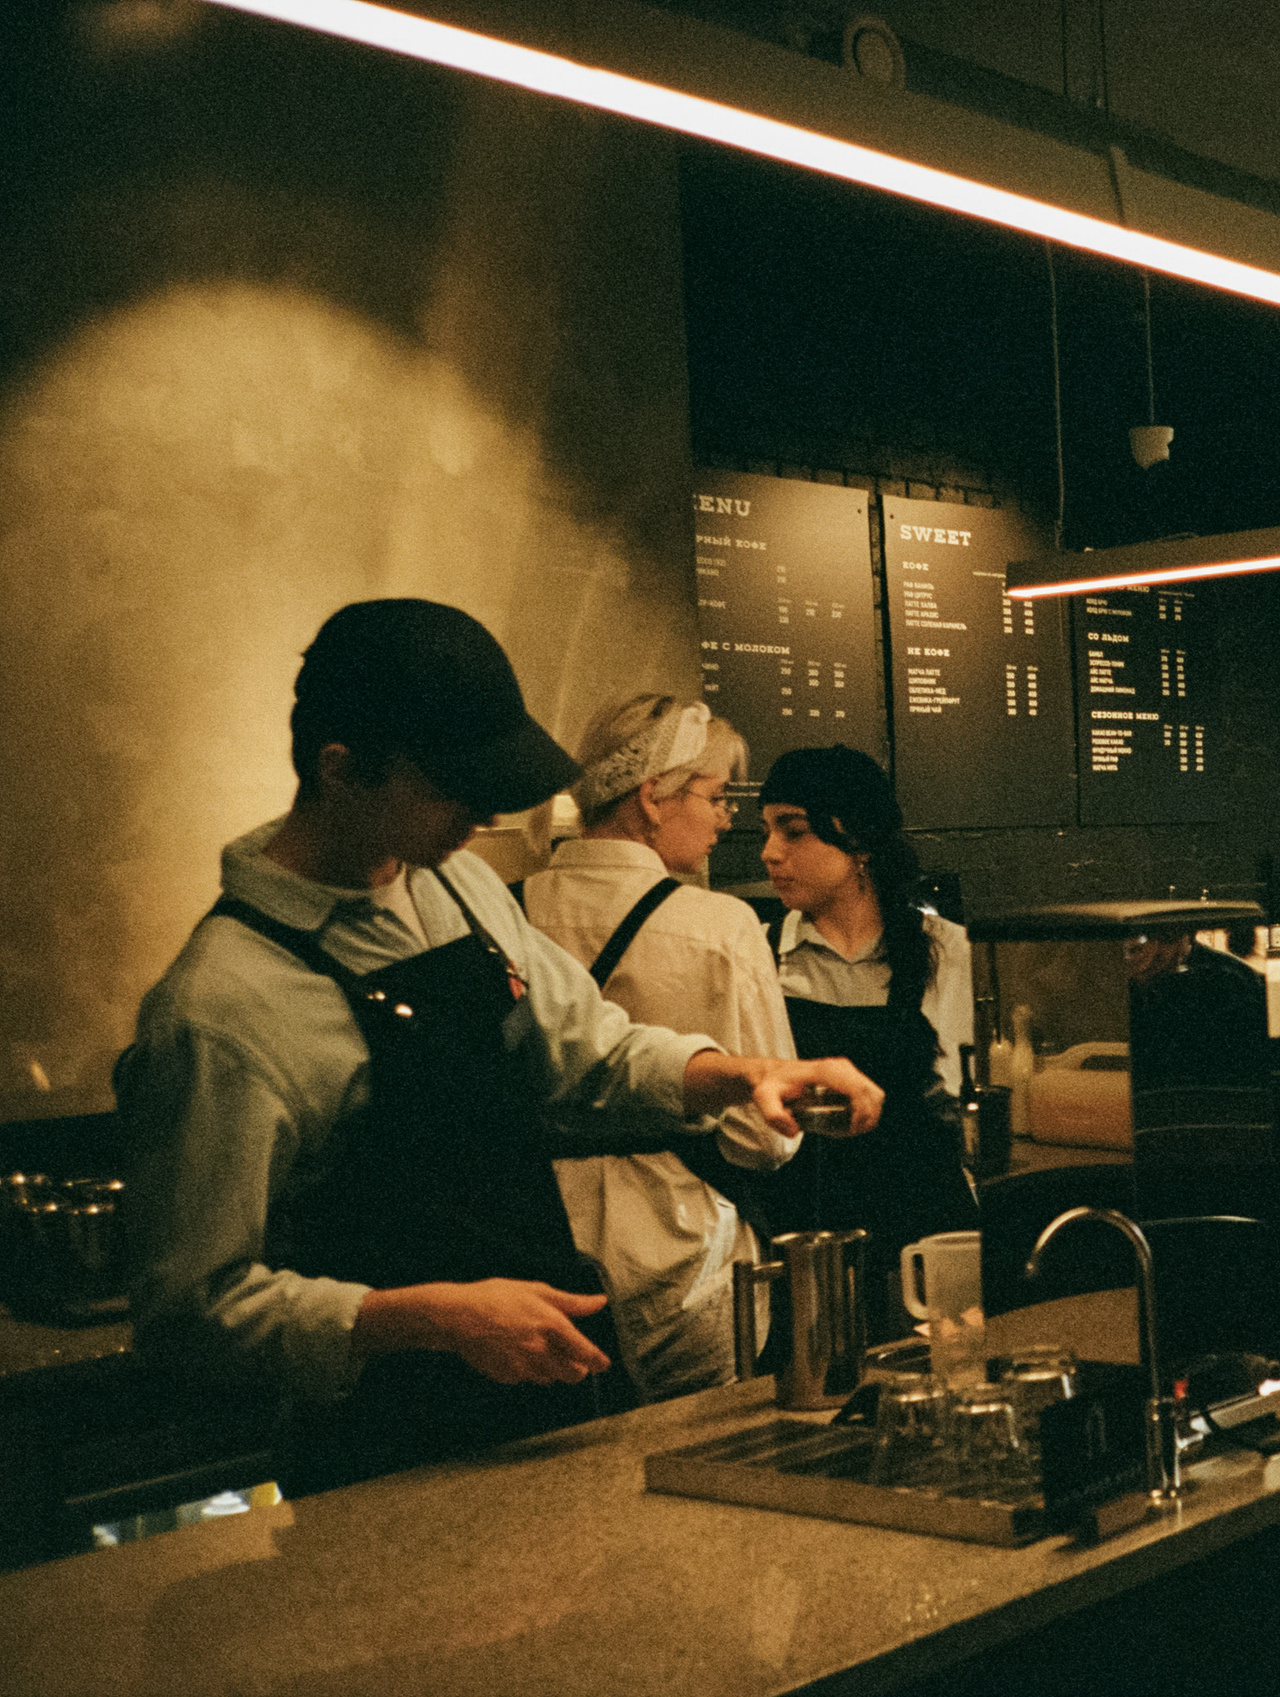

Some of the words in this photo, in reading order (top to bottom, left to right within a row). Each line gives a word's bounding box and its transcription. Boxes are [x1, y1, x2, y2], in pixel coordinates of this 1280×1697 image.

[900, 524, 971, 547] SWEET
[736, 539, 767, 551] КОФЕ
[902, 561, 930, 572] КОФЕ
[1087, 631, 1099, 641] СО
[1101, 632, 1129, 644] ЛЬДОМ
[722, 642, 731, 652] С
[734, 643, 790, 656] МОЛОКОМ
[907, 646, 921, 656] НЕ
[924, 647, 950, 658] КОФЕ
[1091, 710, 1134, 720] СЕЗОННОЕ
[1135, 711, 1160, 721] МЕНЮ
